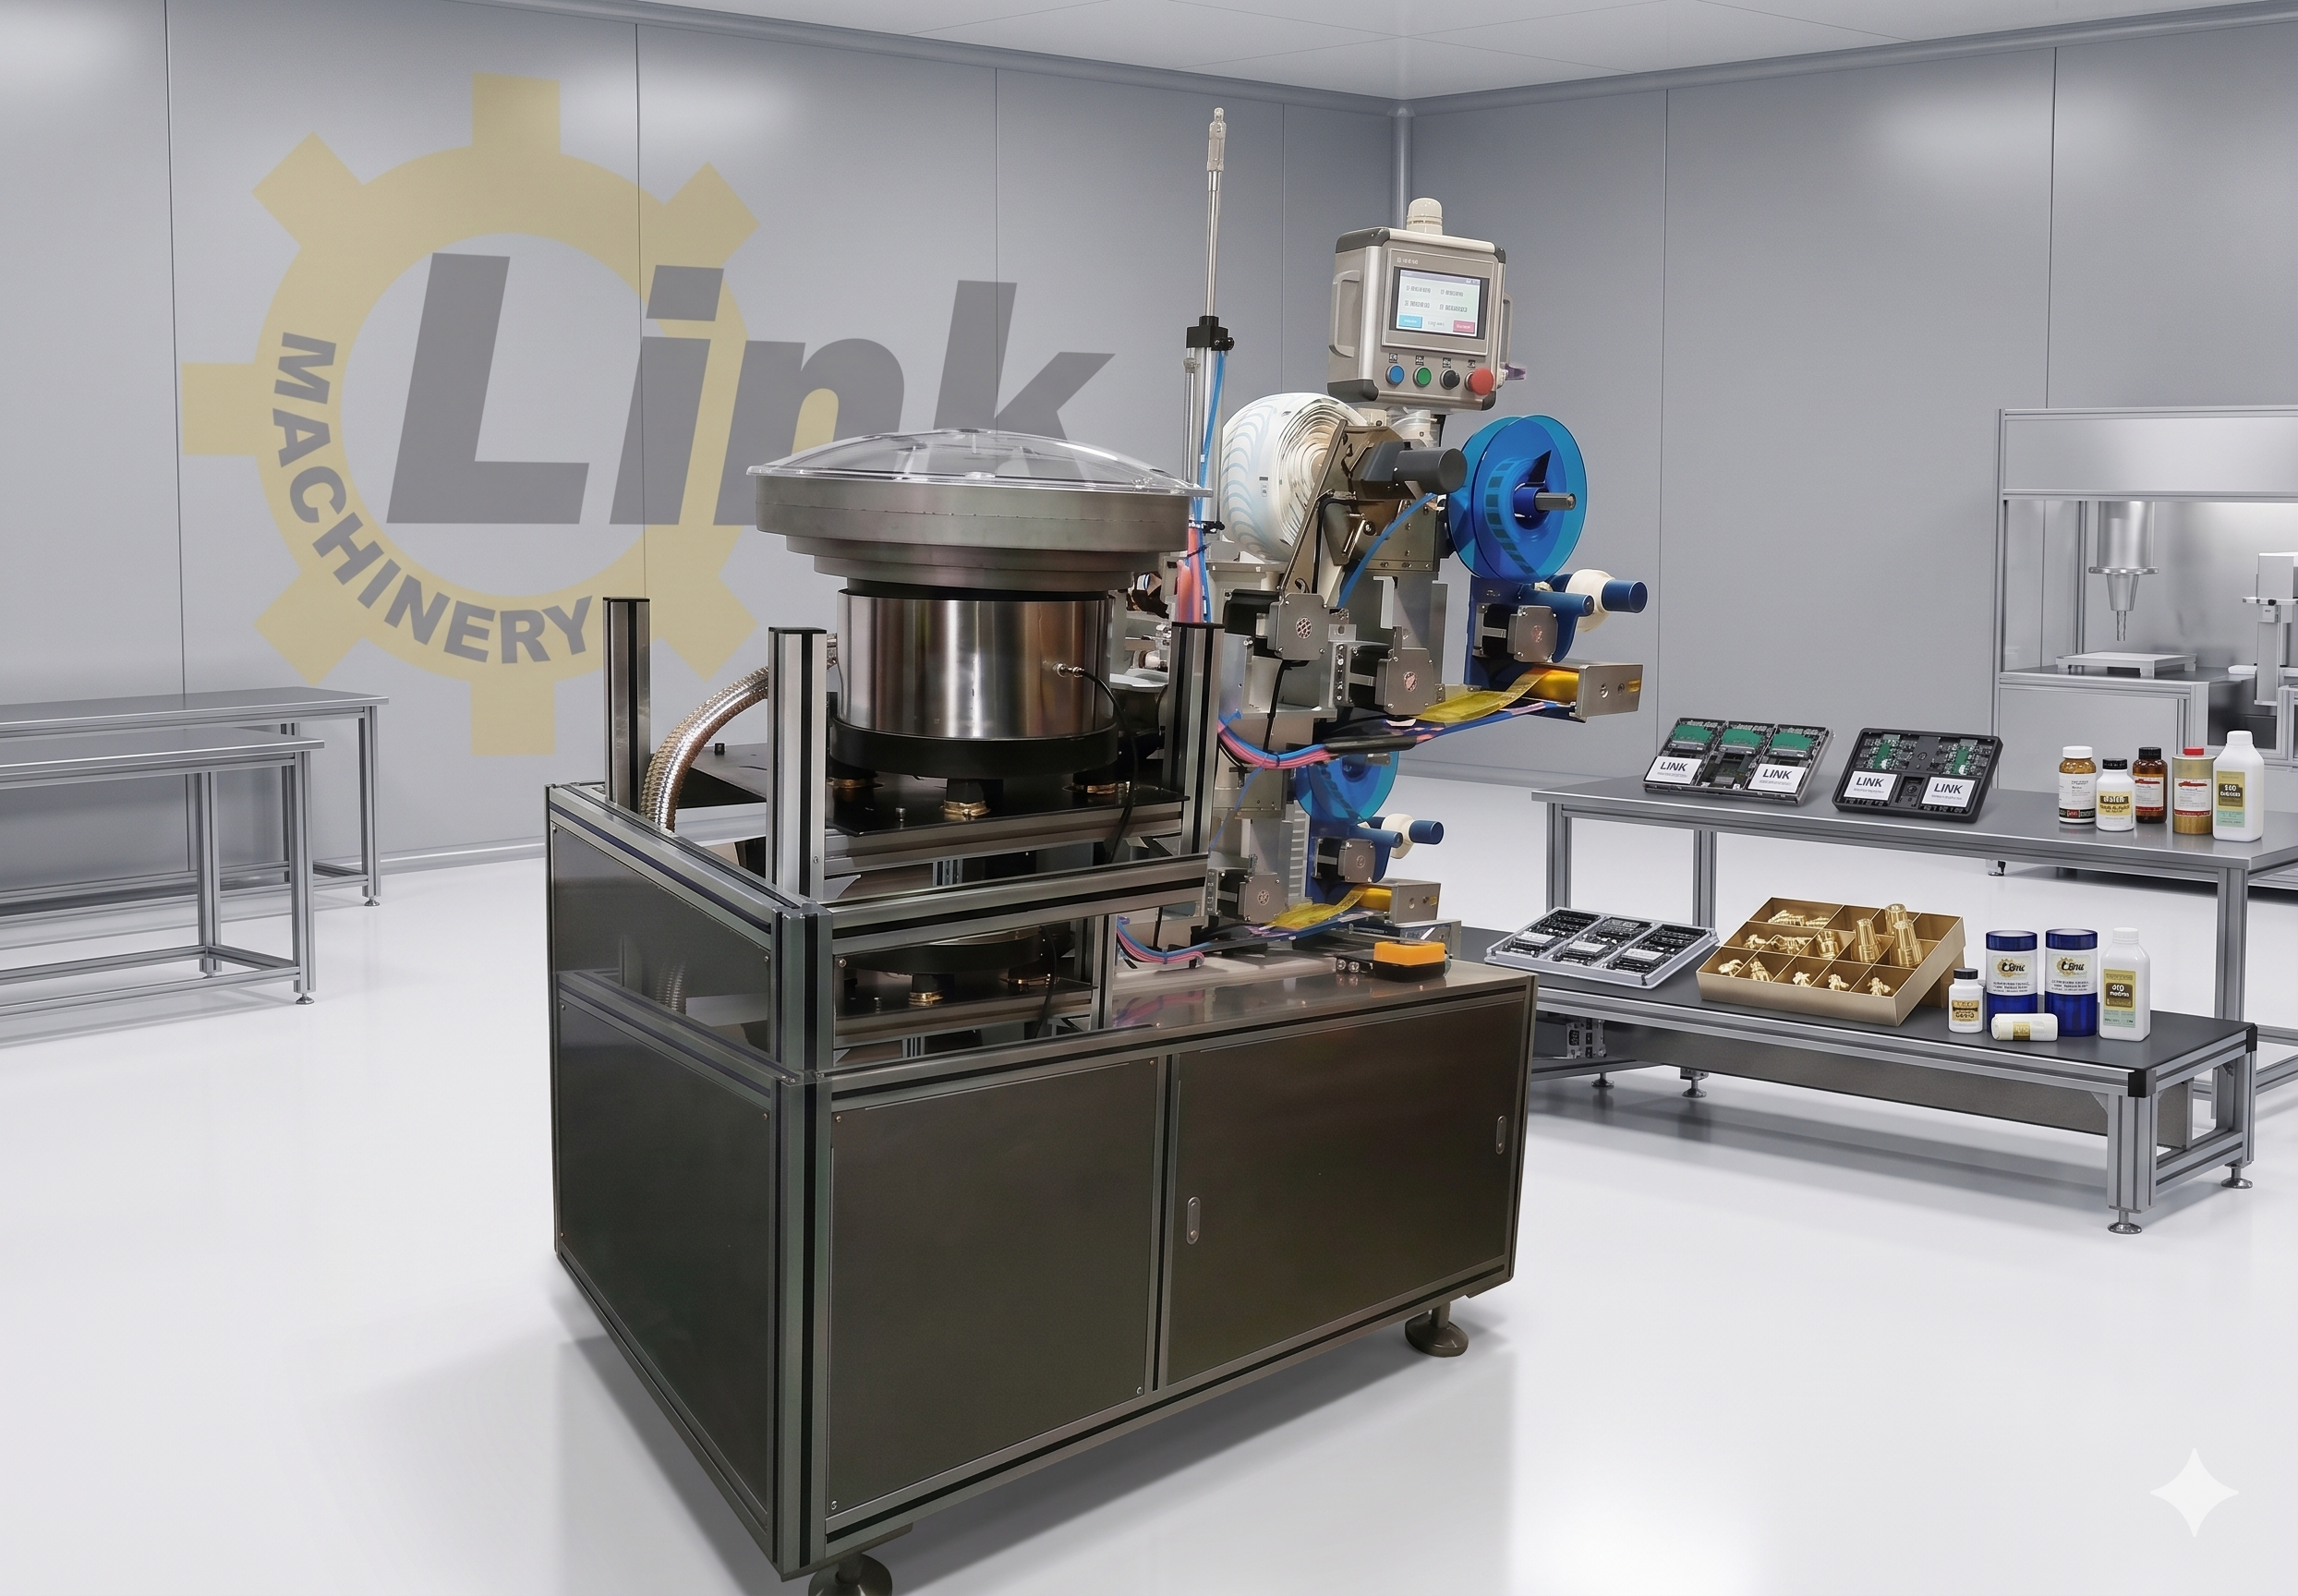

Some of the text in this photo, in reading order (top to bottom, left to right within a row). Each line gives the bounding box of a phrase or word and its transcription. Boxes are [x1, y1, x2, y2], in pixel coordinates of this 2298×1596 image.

[386, 252, 1116, 526] Link
[272, 332, 594, 666] MACHINERY
[1660, 761, 1688, 772] LINK
[1762, 768, 1793, 780] LINK
[1856, 777, 1885, 788] LINK
[1933, 782, 1964, 794] LINK
